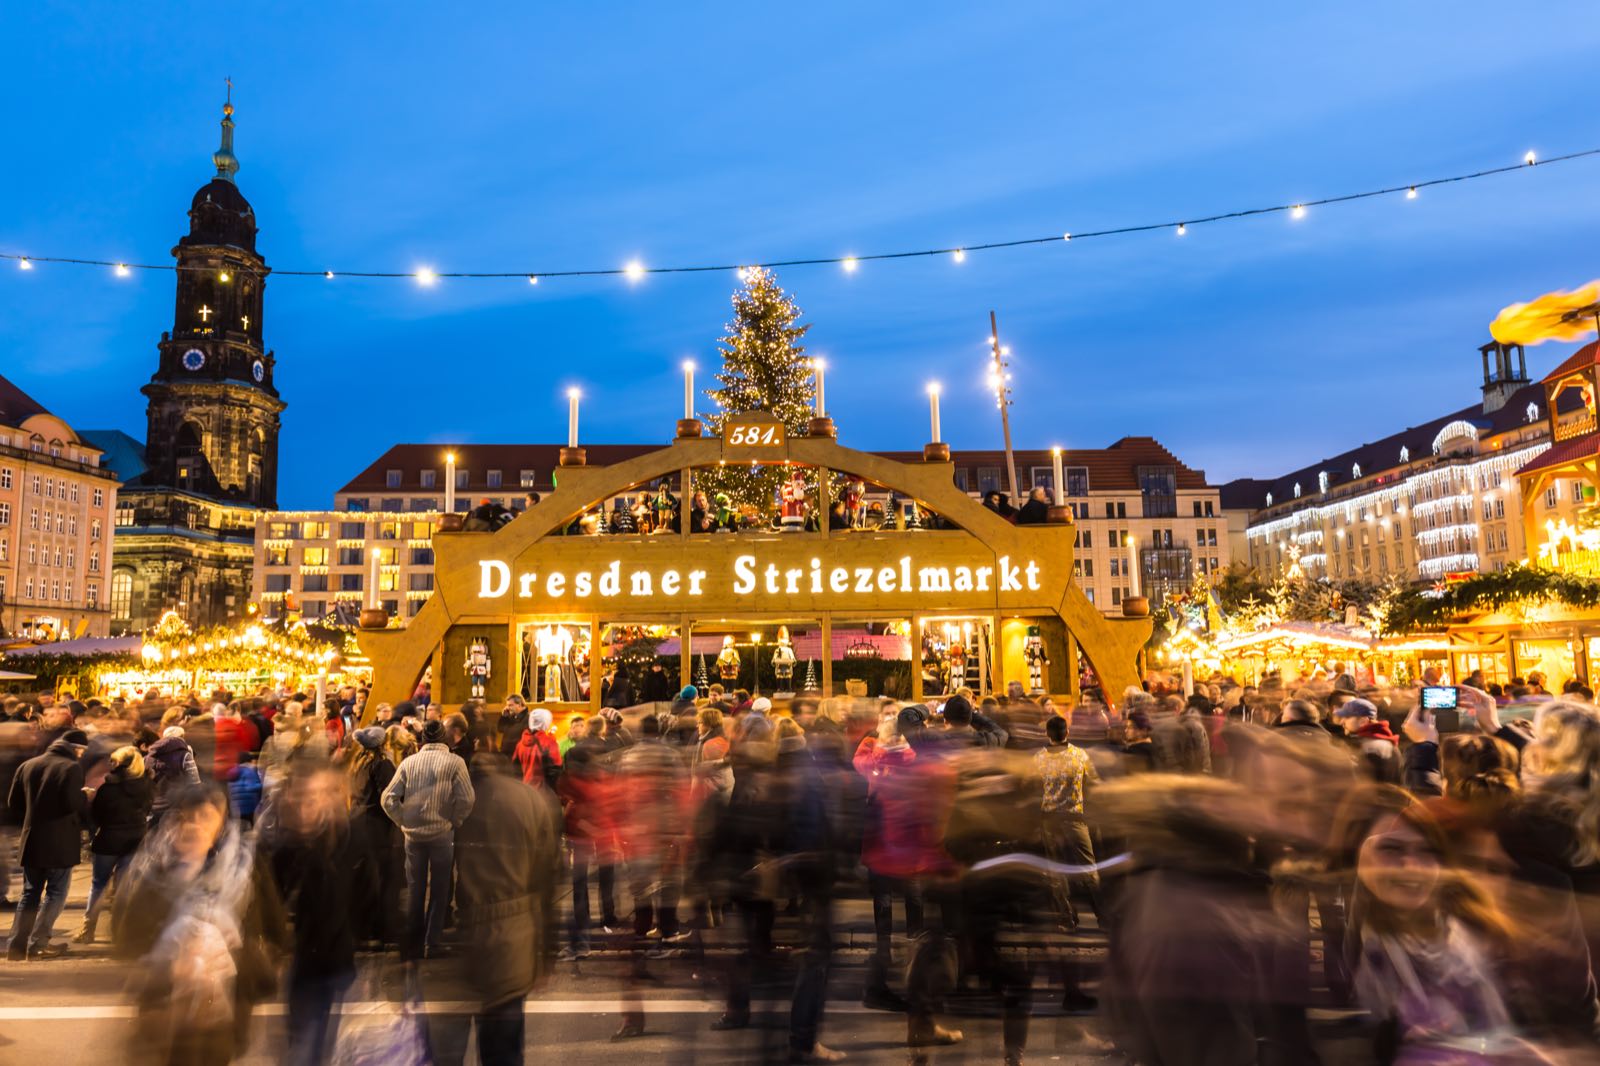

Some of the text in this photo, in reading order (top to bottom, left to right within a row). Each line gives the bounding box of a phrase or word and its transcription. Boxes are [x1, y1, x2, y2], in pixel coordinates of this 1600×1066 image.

[729, 425, 780, 445] 581.
[478, 554, 1041, 598] Dresdner Striezelmarkt
